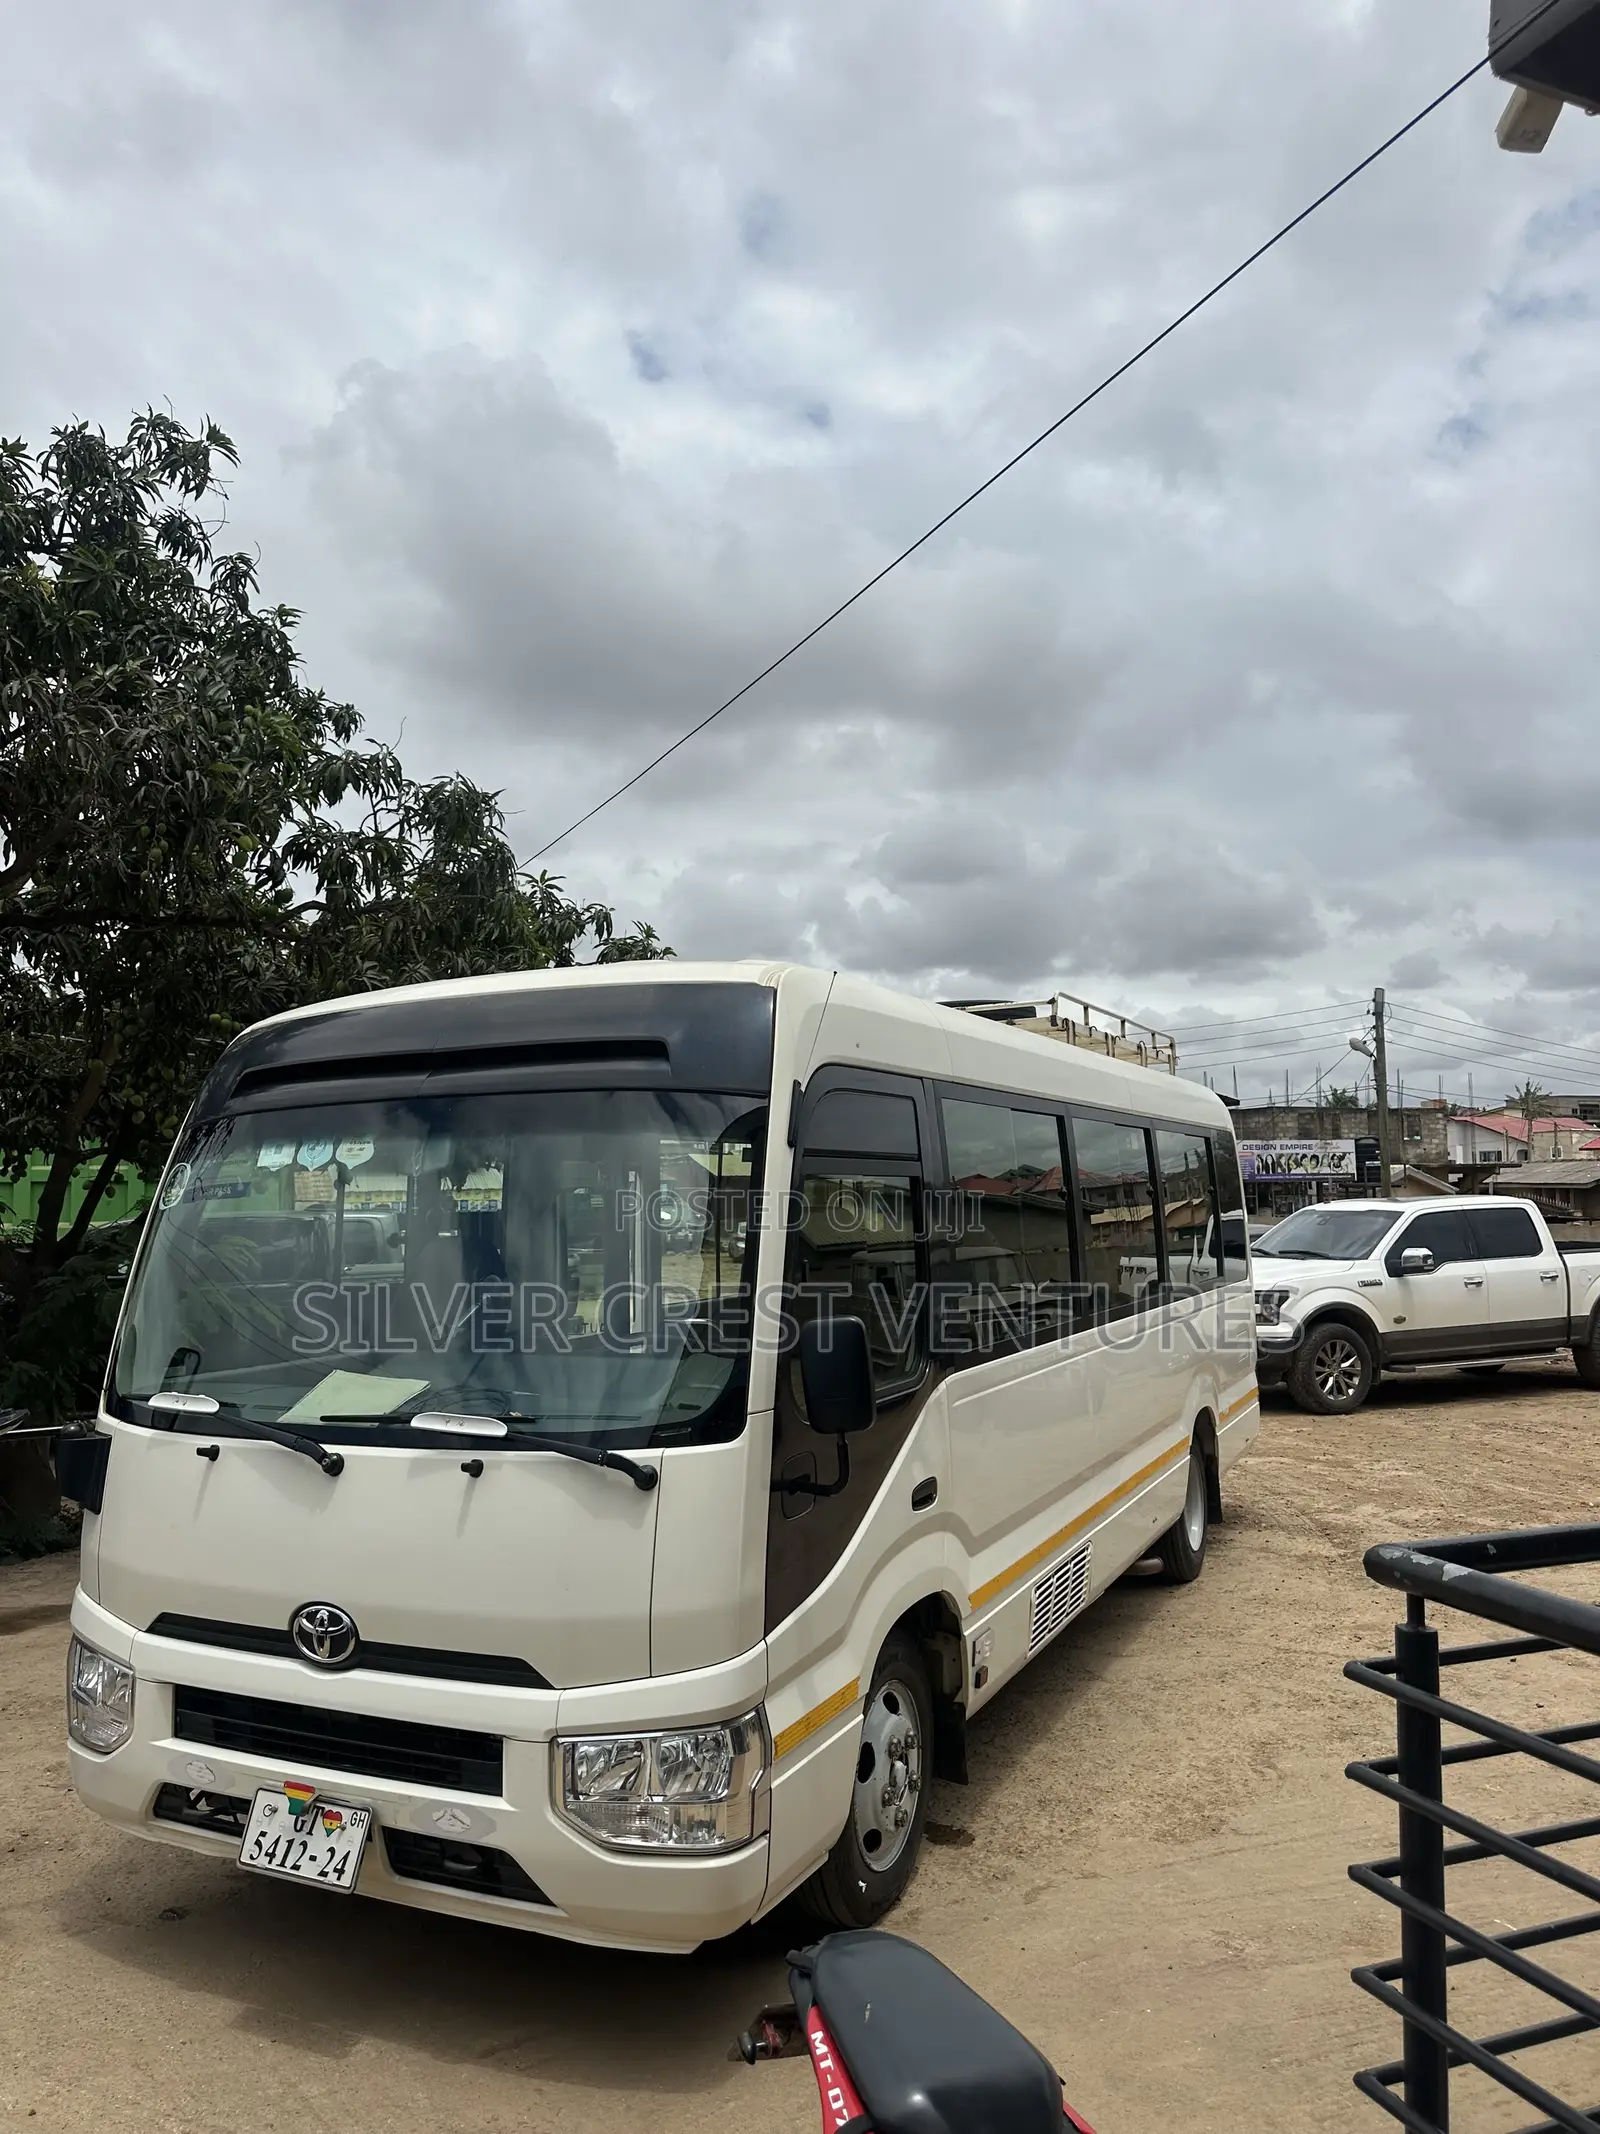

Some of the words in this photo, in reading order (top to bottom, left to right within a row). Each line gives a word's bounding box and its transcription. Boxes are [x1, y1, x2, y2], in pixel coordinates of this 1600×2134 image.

[294, 1804, 325, 1836] GT
[350, 1811, 367, 1829] GH
[249, 1831, 351, 1881] 5412-24
[810, 2030, 849, 2127] MT-07
